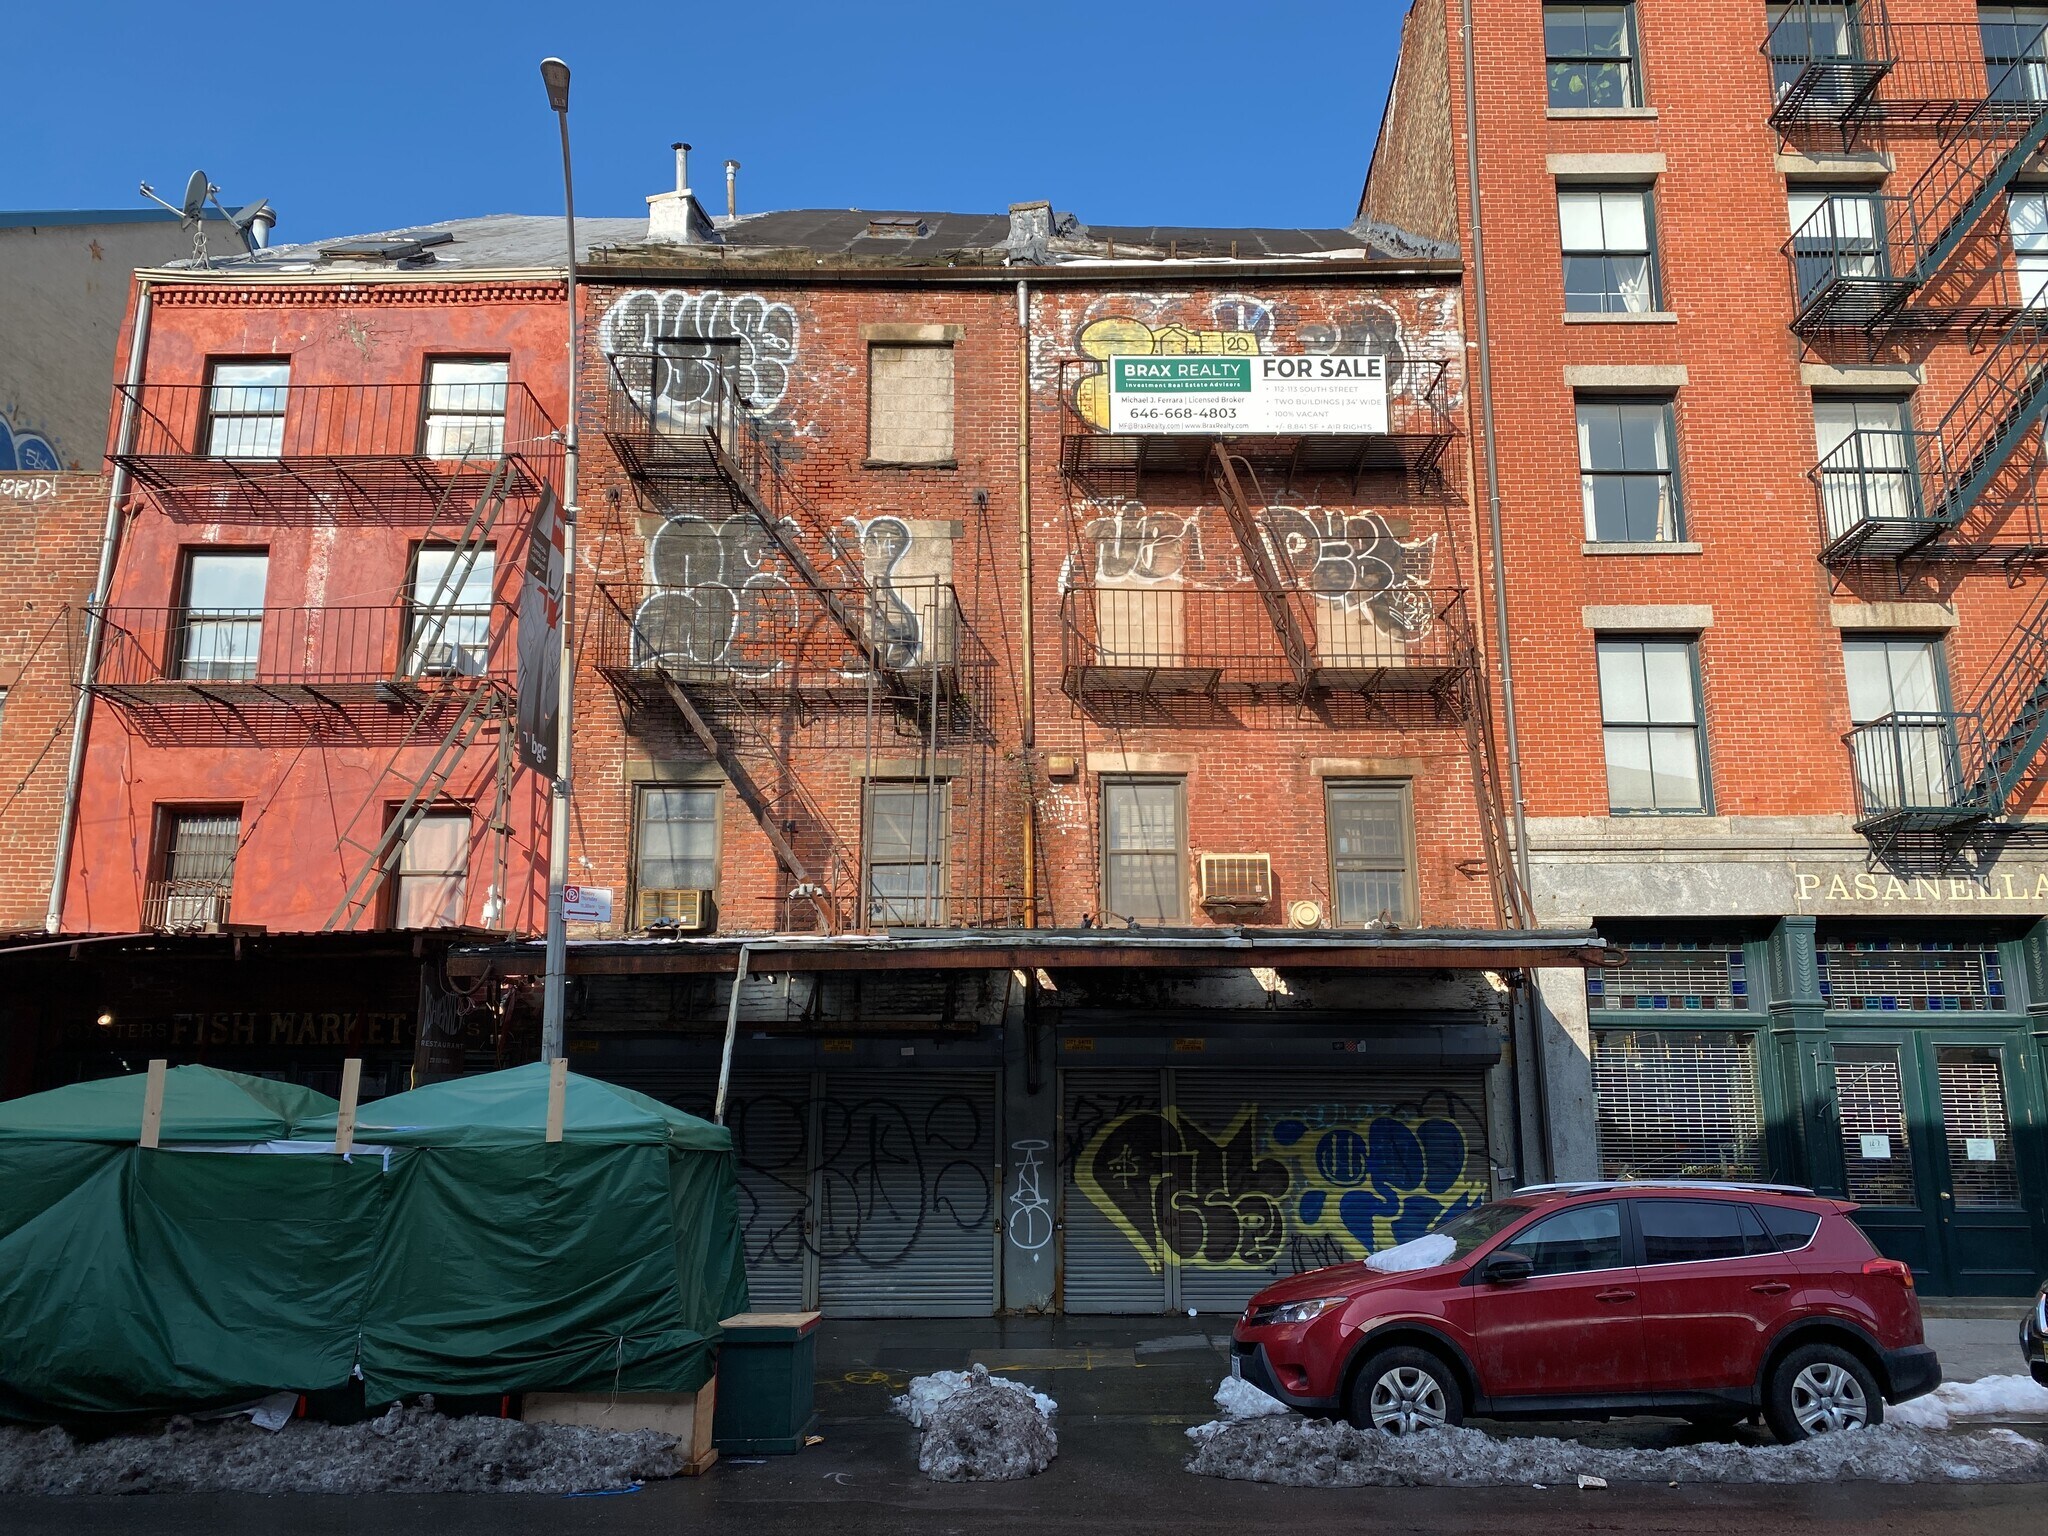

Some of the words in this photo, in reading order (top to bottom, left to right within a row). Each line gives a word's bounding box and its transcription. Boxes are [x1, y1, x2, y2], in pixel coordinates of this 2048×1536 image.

[1226, 336, 1249, 352] 20
[1124, 364, 1171, 377] BRAX
[1178, 363, 1240, 377] REALTY
[1263, 358, 1312, 377] FOR
[1320, 358, 1381, 378] SALE
[1274, 385, 1298, 393] 112-113
[1299, 385, 1327, 393] SOUTH
[1329, 385, 1359, 393] STREET
[1121, 396, 1149, 404] Michael
[1149, 396, 1156, 404] J.
[1157, 396, 1183, 404] Ferrara
[1188, 396, 1220, 404] Licensed
[1221, 396, 1245, 404] Broker
[1274, 398, 1294, 406] TWO
[1295, 398, 1340, 406] BUILDINGS
[1359, 398, 1382, 406] WIDE
[1130, 408, 1237, 419] 646-668-4803
[1274, 410, 1295, 418] 100%
[1296, 410, 1329, 418] VACANT
[1118, 421, 1181, 431] MF@BraxRealty.com
[1184, 421, 1250, 430] www.BraxRealty.com
[1327, 423, 1341, 431] AIR
[1342, 423, 1372, 431] RIGHTS
[531, 733, 547, 764] bgc
[1795, 873, 2048, 901] PASANELLA
[169, 1012, 256, 1046] FISH
[268, 1012, 407, 1046] MARKET
[420, 1039, 466, 1049] RESTAURANT
